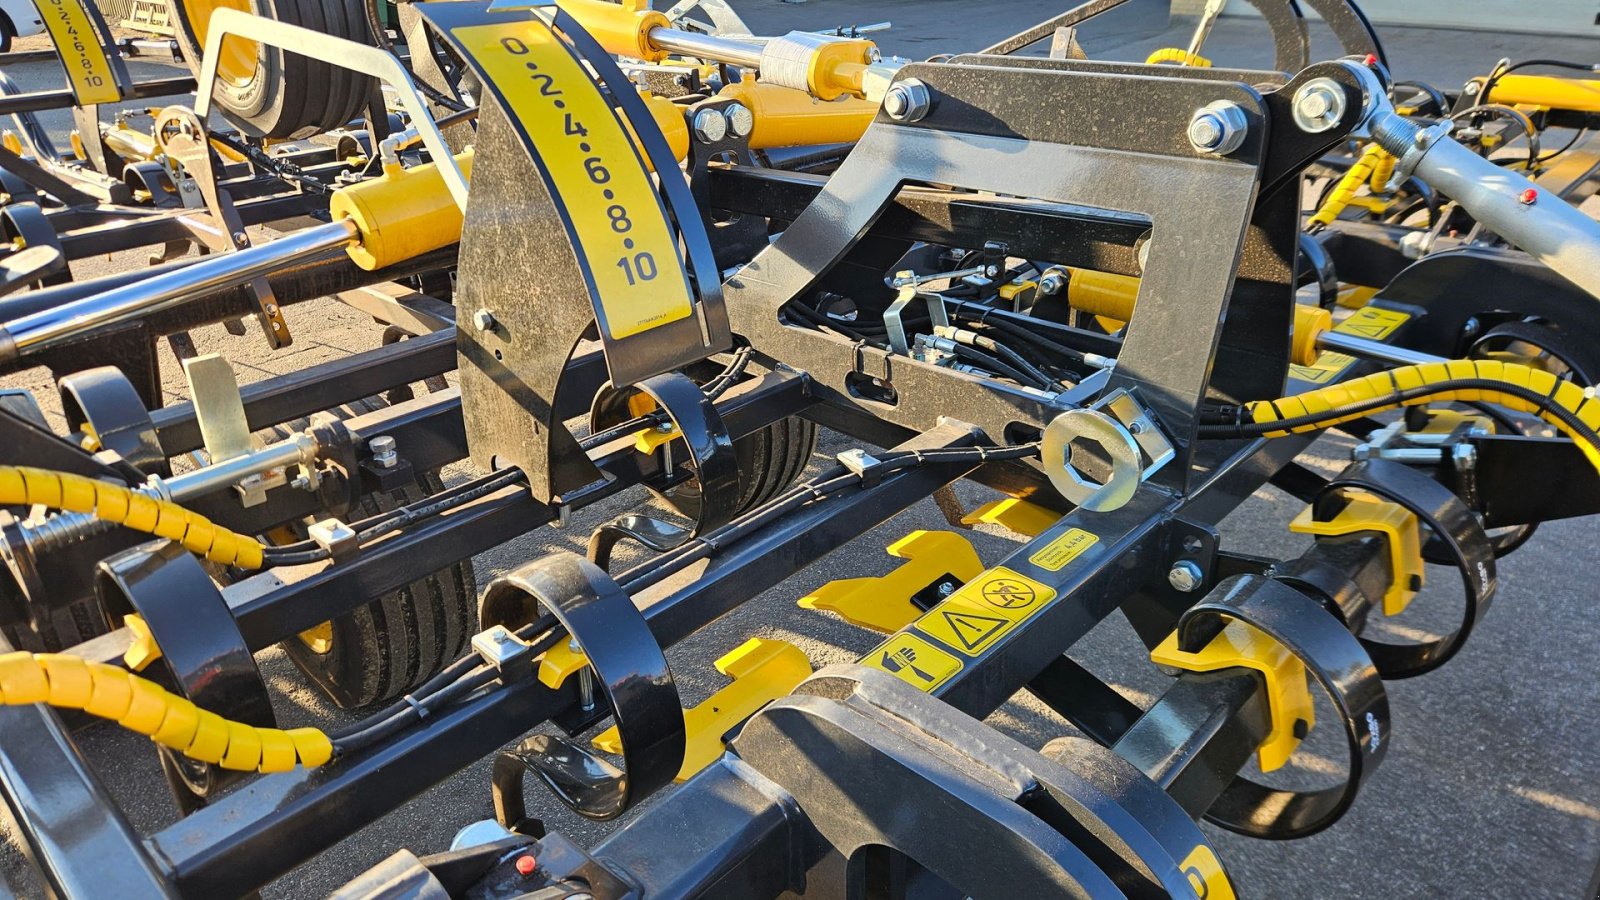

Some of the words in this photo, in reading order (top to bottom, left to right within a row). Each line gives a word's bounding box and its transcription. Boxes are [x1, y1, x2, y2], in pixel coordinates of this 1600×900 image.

[59, 11, 70, 21] 2
[67, 26, 78, 35] 4
[74, 42, 85, 52] 6
[500, 37, 529, 55] 0
[81, 59, 92, 69] 8
[84, 76, 103, 87] 10
[531, 74, 562, 97] 2
[564, 113, 587, 137] 4
[583, 157, 611, 184] 6
[606, 204, 632, 234] 8
[617, 251, 658, 286] 10
